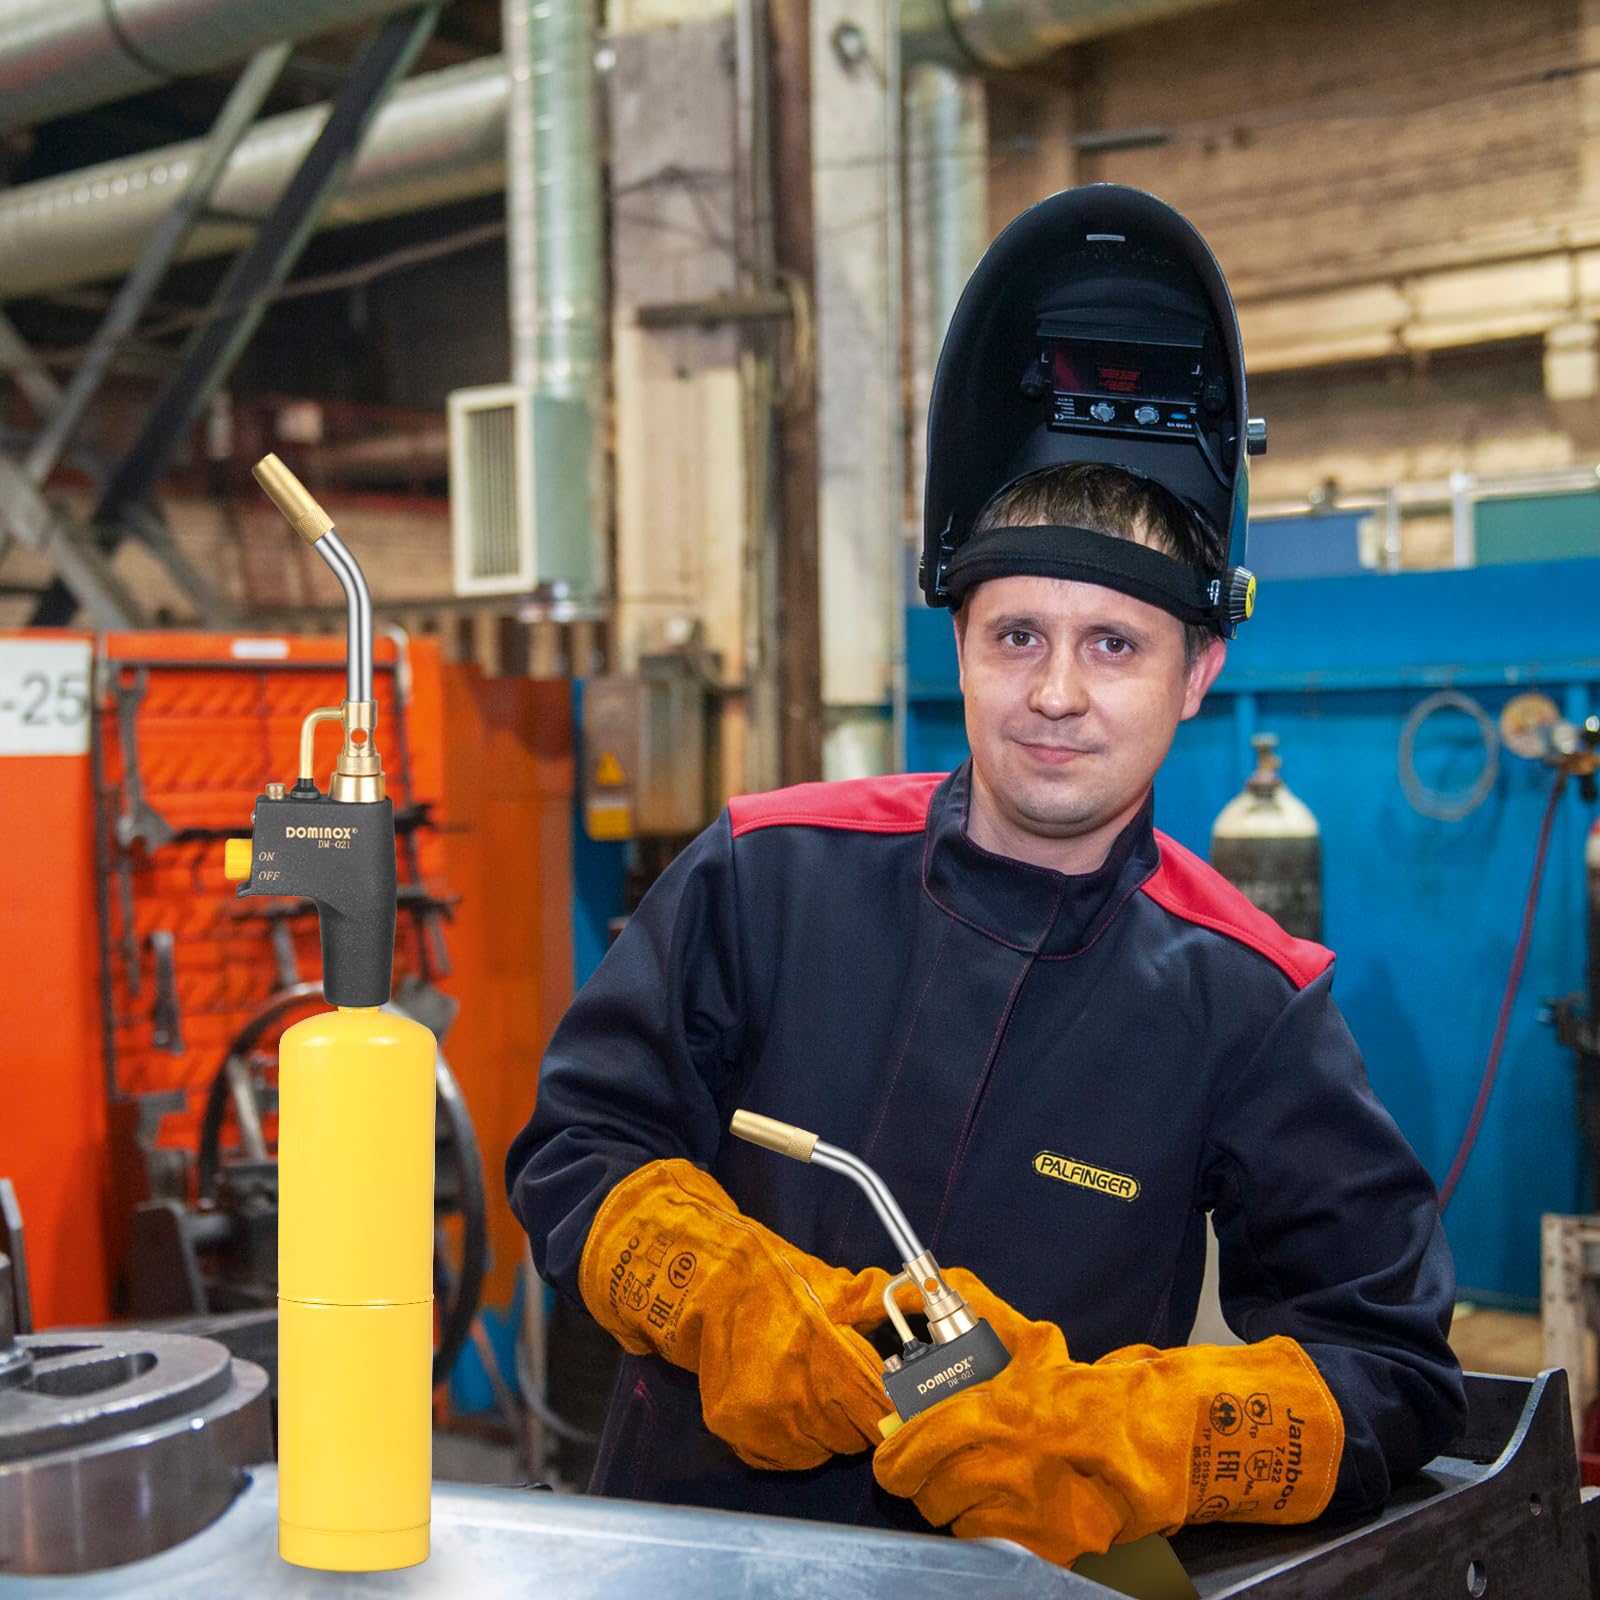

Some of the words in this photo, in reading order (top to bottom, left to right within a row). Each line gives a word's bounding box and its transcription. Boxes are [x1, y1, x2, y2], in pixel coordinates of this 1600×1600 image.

[258, 851, 275, 861] ON
[258, 871, 280, 880] OFF
[1040, 1157, 1132, 1196] PALFINGER
[672, 1256, 693, 1281] 10
[1271, 1446, 1285, 1483] 7.422
[1274, 1408, 1305, 1510] Jamboo
